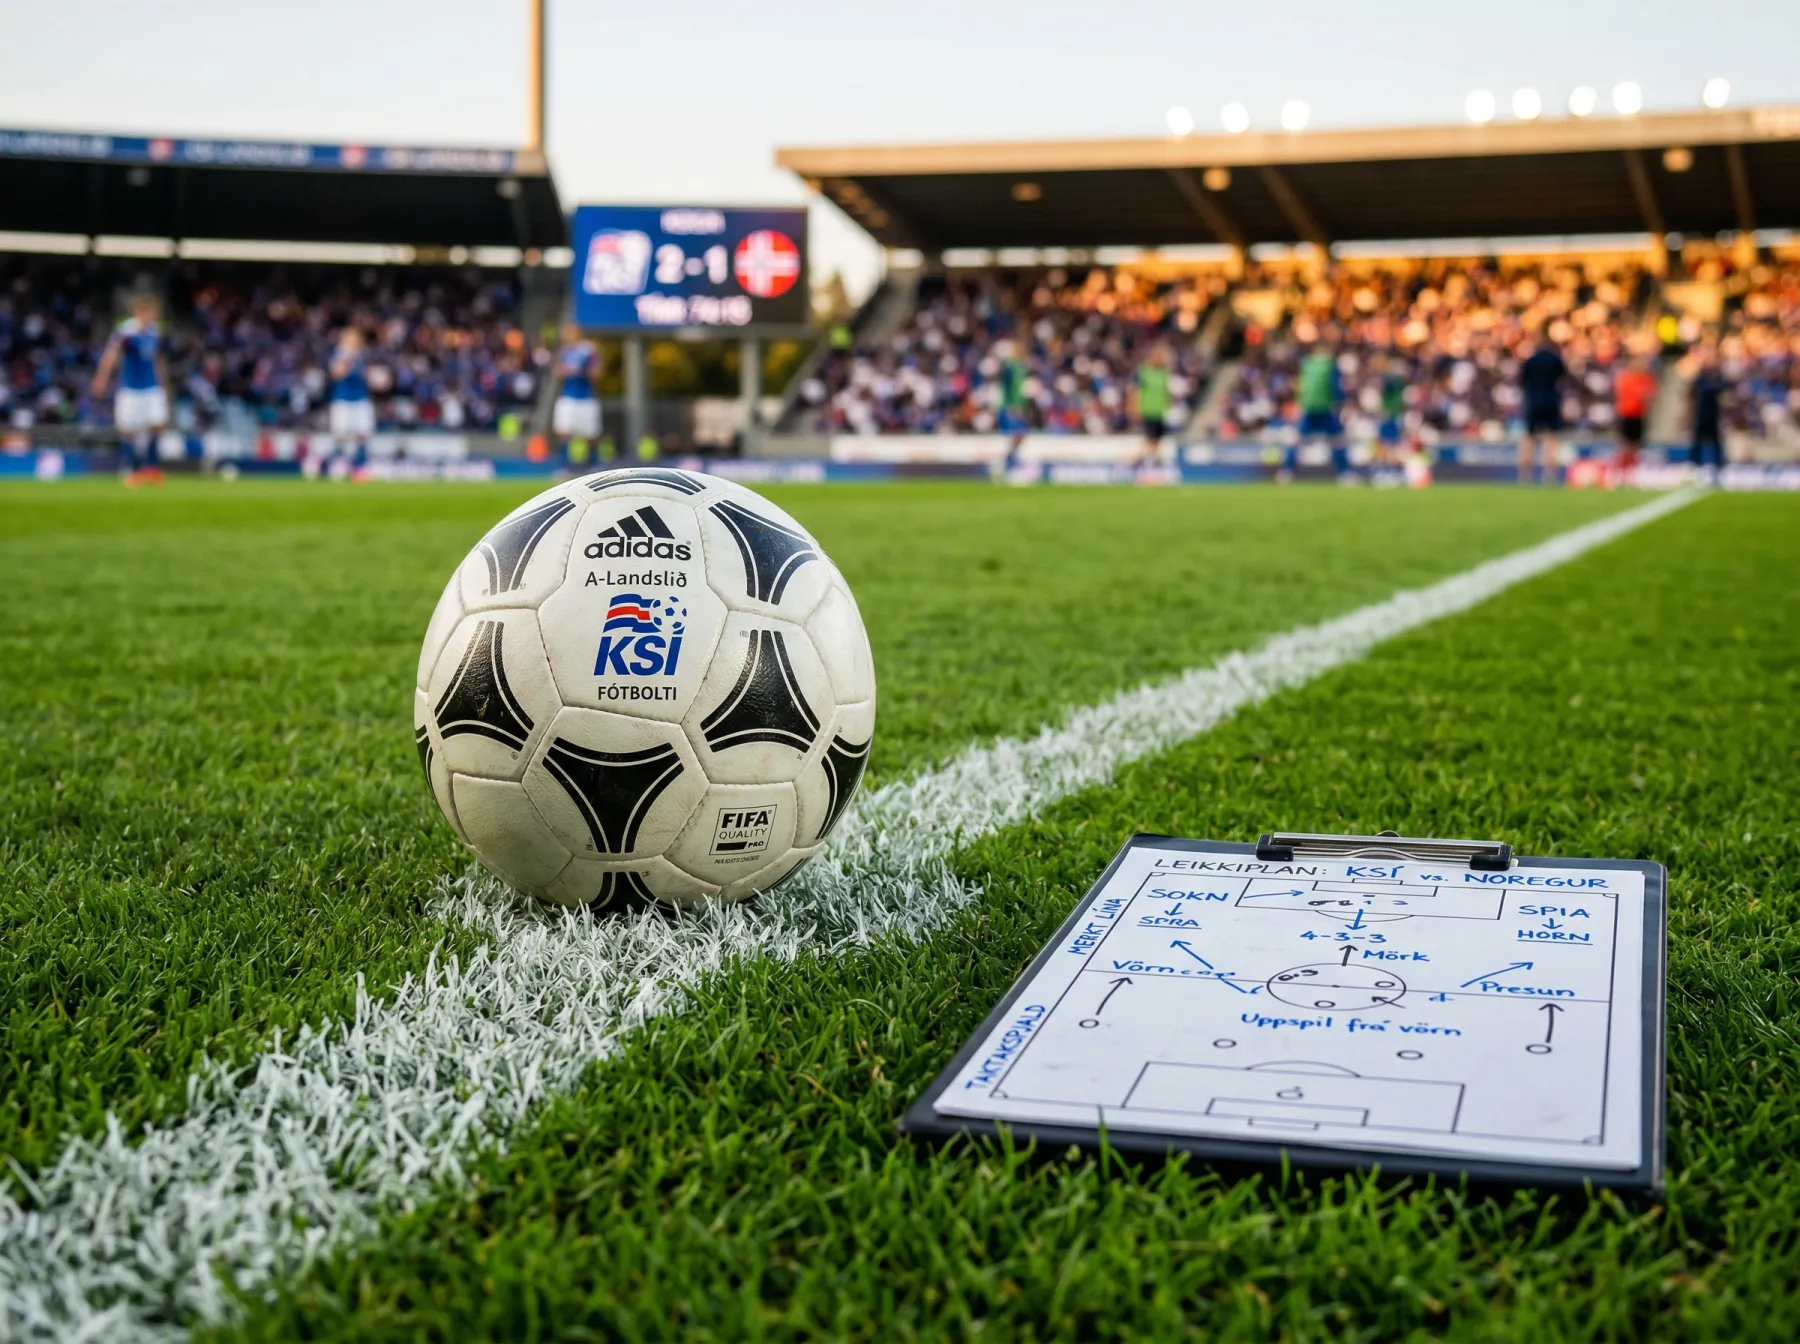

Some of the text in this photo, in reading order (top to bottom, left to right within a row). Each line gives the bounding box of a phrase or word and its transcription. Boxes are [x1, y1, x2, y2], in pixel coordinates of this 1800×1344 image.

[584, 536, 691, 561] adidas
[585, 569, 687, 588] A-Landslið
[598, 683, 677, 701] FÓTBOLTI
[721, 811, 769, 829] FIFA
[718, 828, 768, 840] QUALITY
[1154, 858, 1327, 876] LEIKKIPLAN:
[1464, 873, 1609, 889] NOREGUR
[1147, 888, 1229, 902] SOKN
[1518, 905, 1591, 919] SPIA
[1067, 922, 1109, 955] MERKT
[1299, 930, 1387, 943] 4-3-3
[1517, 930, 1590, 942] HORN
[1362, 949, 1431, 962] Mörk
[1479, 981, 1575, 997] Presun
[1241, 1013, 1333, 1031] Uppspil
